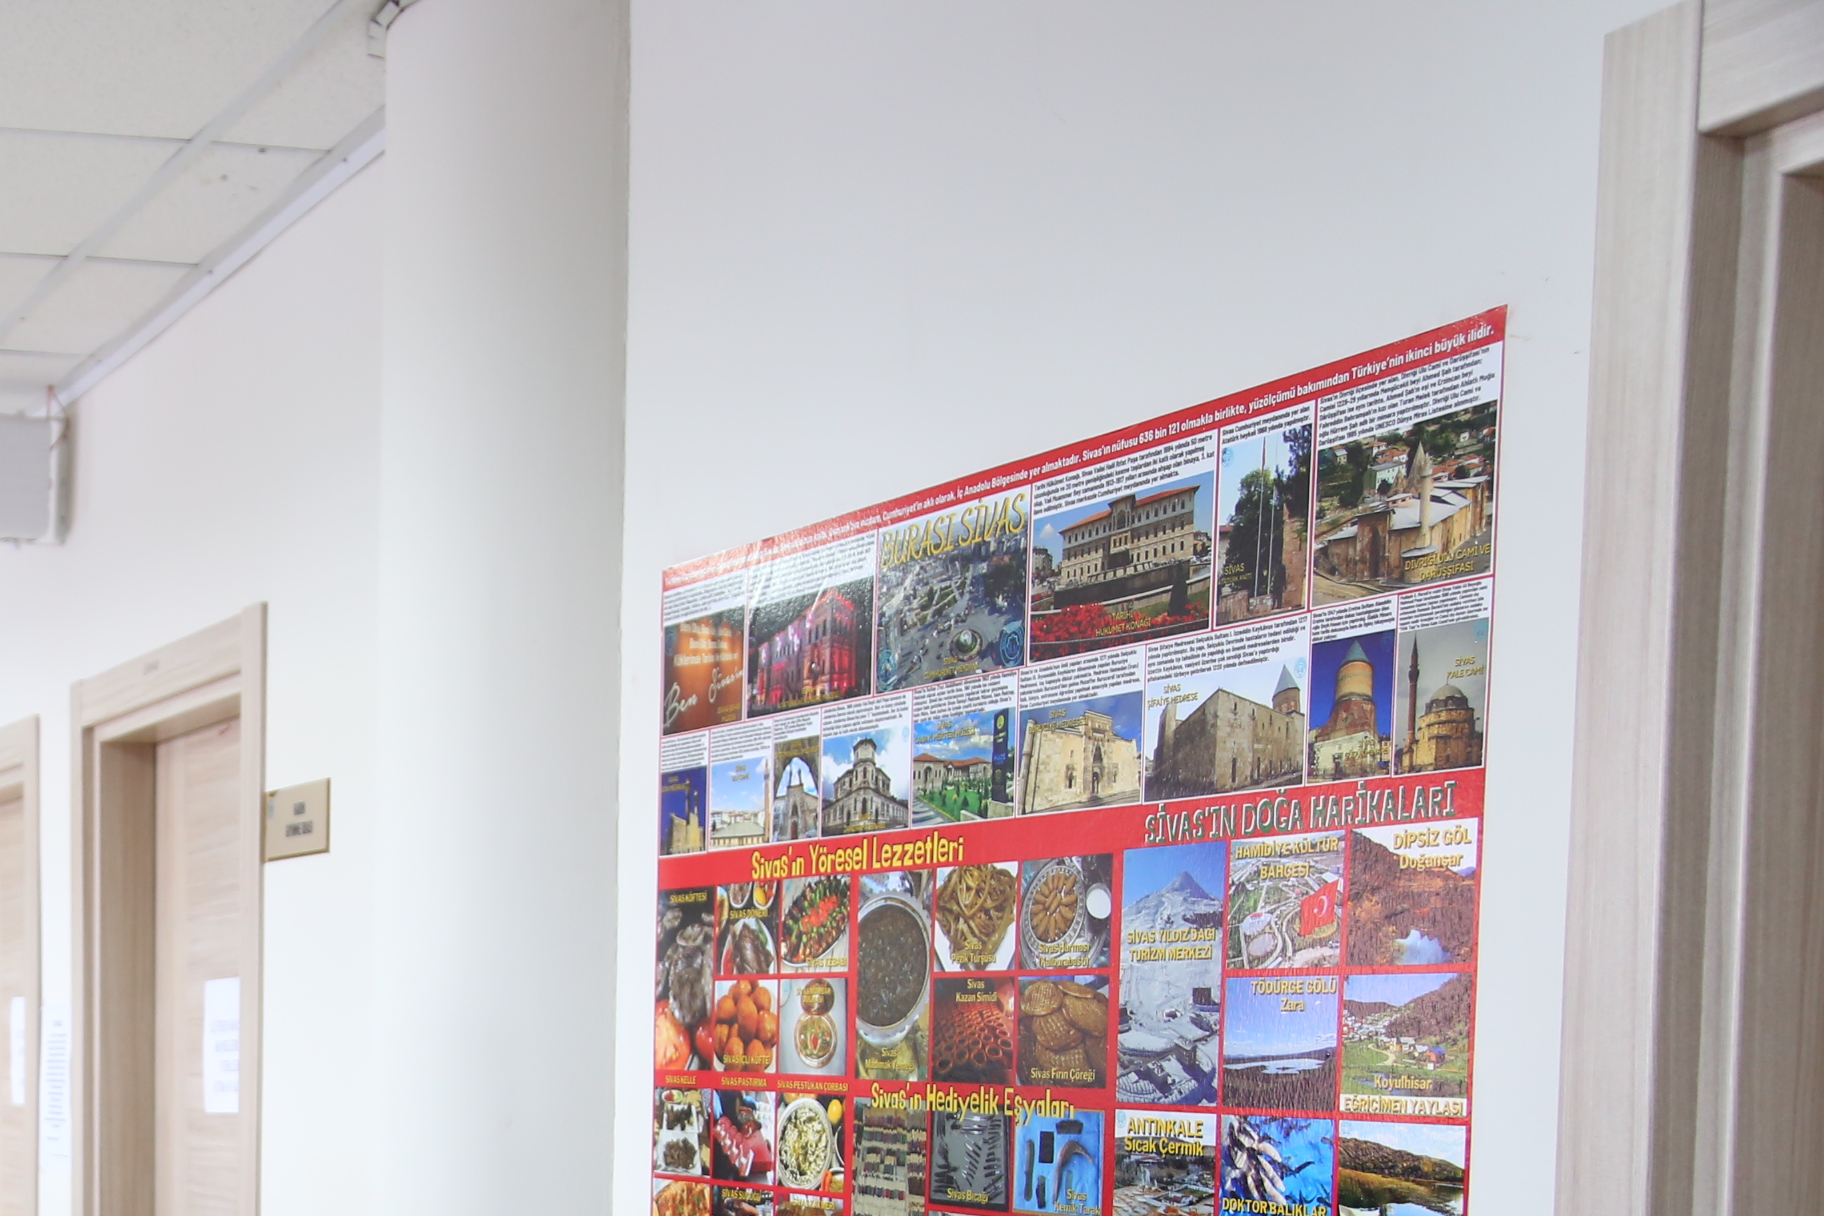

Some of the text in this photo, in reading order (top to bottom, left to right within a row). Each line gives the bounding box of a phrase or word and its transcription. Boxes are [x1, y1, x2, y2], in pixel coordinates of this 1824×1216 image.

[964, 480, 991, 497] Anadolu
[991, 469, 1028, 488] Bölgesinde
[1028, 467, 1040, 480] yer
[1041, 453, 1081, 474] almaktadır.
[1082, 443, 1111, 461] Sivas'ın
[1111, 437, 1138, 453] nüfusu
[1139, 429, 1153, 444] 636
[1155, 426, 1168, 440] bin
[1168, 421, 1180, 435] 121
[1181, 413, 1213, 431] olmakla
[1214, 404, 1247, 422] birlikte,
[1248, 385, 1295, 414] yüzölçümü
[1297, 372, 1350, 396] bakımından
[1351, 354, 1404, 380] Türkiye'nin
[1405, 343, 1433, 364] ikinci
[1434, 333, 1466, 355] büyük
[1467, 324, 1494, 343] ilidir.
[881, 513, 957, 568] BURASI
[959, 493, 1026, 547] SİVAS
[1455, 543, 1491, 561] CAMİ VE
[1144, 780, 1457, 844] SİVAS'IN DOĞA HARİKALARI
[1393, 824, 1472, 849] DİPSİZ GÖL
[751, 831, 964, 880] Sivas'ın Yöresel Lezzetleri
[1235, 835, 1339, 859] HAMİDİYE KÜLTÜR
[1260, 861, 1311, 880] BAHÇESİ
[1399, 853, 1463, 871] Doğanşar
[1127, 924, 1216, 945] SİVAS YILDIZ DAĞI
[1129, 944, 1213, 962] TURİZM MERKEZİ
[967, 979, 985, 989] Sivas
[1251, 975, 1338, 995] TÖDÜRGE GÖLÜ
[955, 991, 998, 1003] Kazan Simidi
[1280, 998, 1304, 1012] Zara
[1030, 1067, 1096, 1085] Sivas Fırın Çöreği
[1374, 1075, 1433, 1092] Koyulhisar
[871, 1082, 1076, 1126] Sivas'ın Hediyelik Eşyaları
[1409, 1099, 1464, 1117] YAYLASI
[1124, 1135, 1204, 1158] Sıcak Çermik
[947, 1188, 990, 1204] Sivas Bıçağı
[1066, 1189, 1087, 1201] Sivas
[1222, 1198, 1268, 1215] DOKTOR
